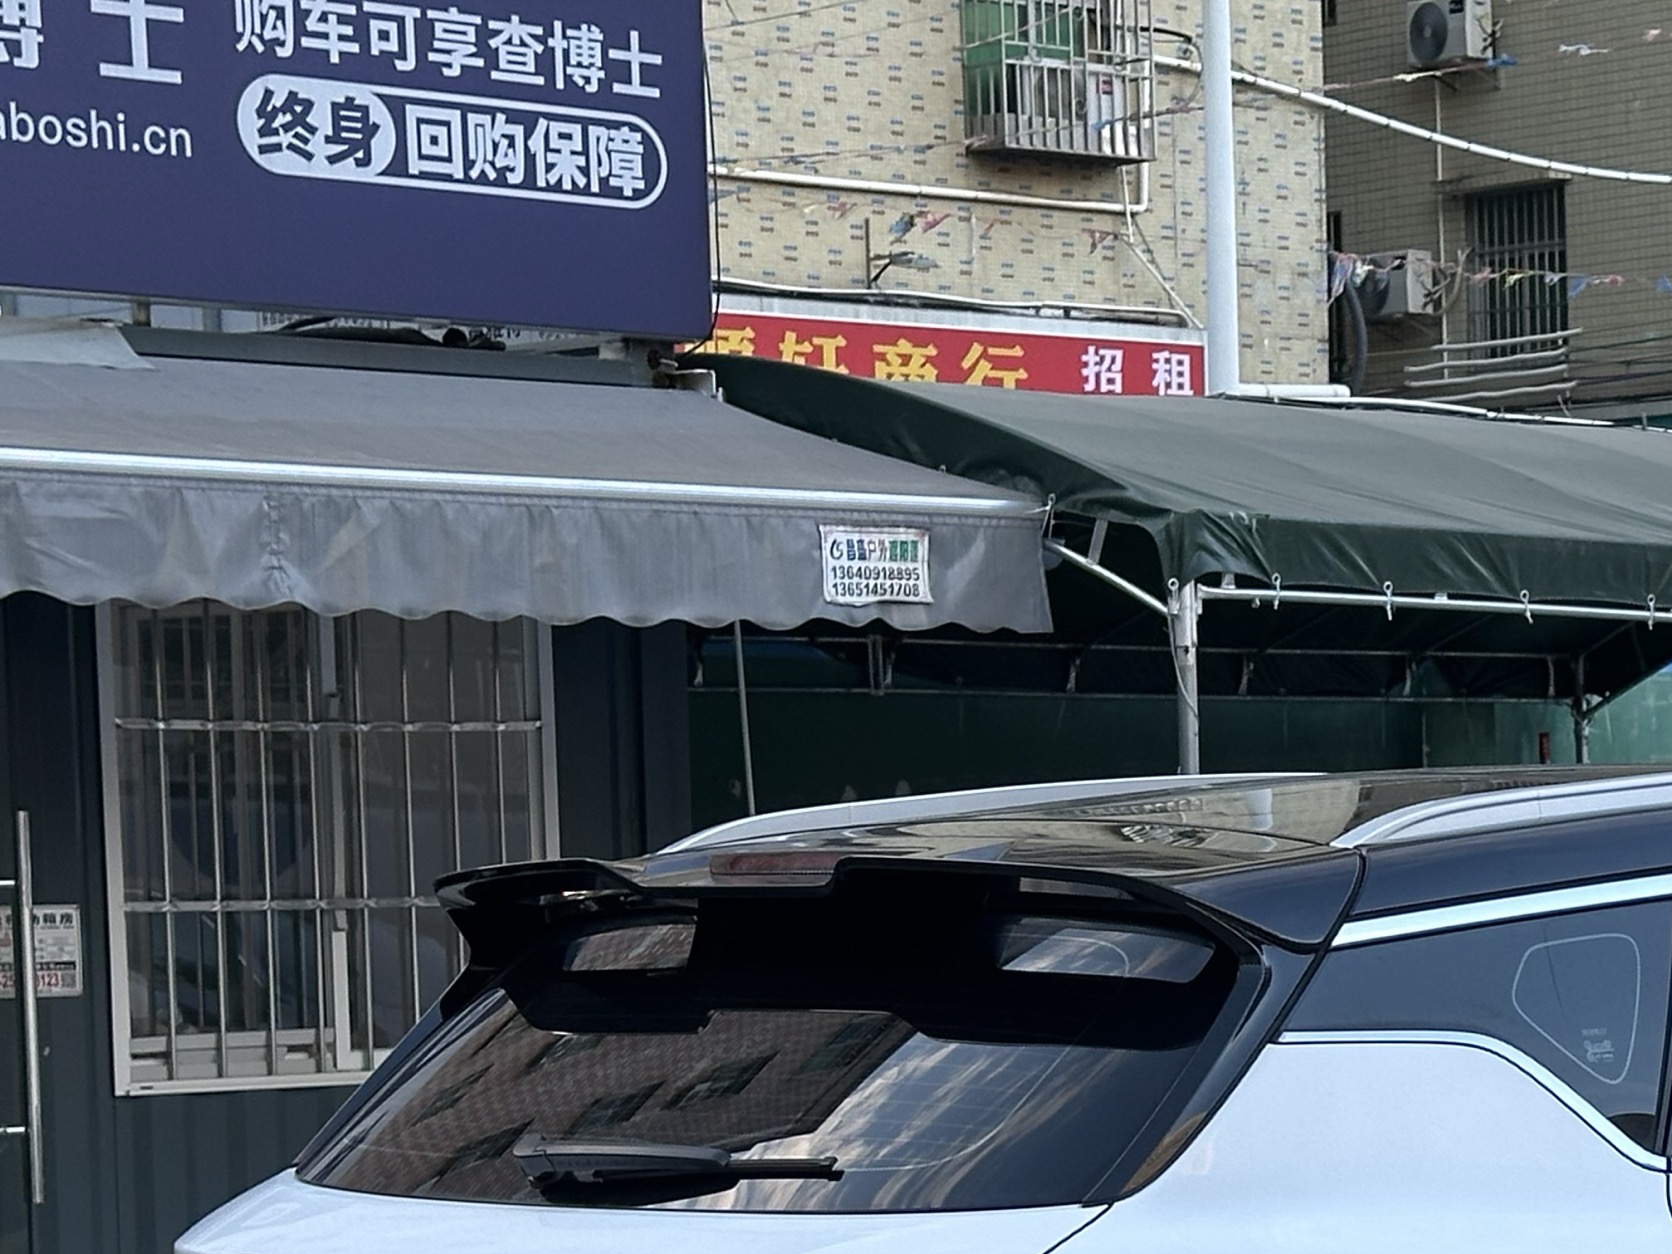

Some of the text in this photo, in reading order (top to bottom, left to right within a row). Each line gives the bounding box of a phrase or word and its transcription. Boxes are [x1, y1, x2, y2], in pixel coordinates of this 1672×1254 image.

[234, 0, 663, 98] 购车可享查博士
[0, 101, 192, 158] boshi.cn
[255, 86, 646, 197] 终身 回购保障
[1081, 345, 1194, 396] 招租
[832, 581, 920, 597] 13651451708
